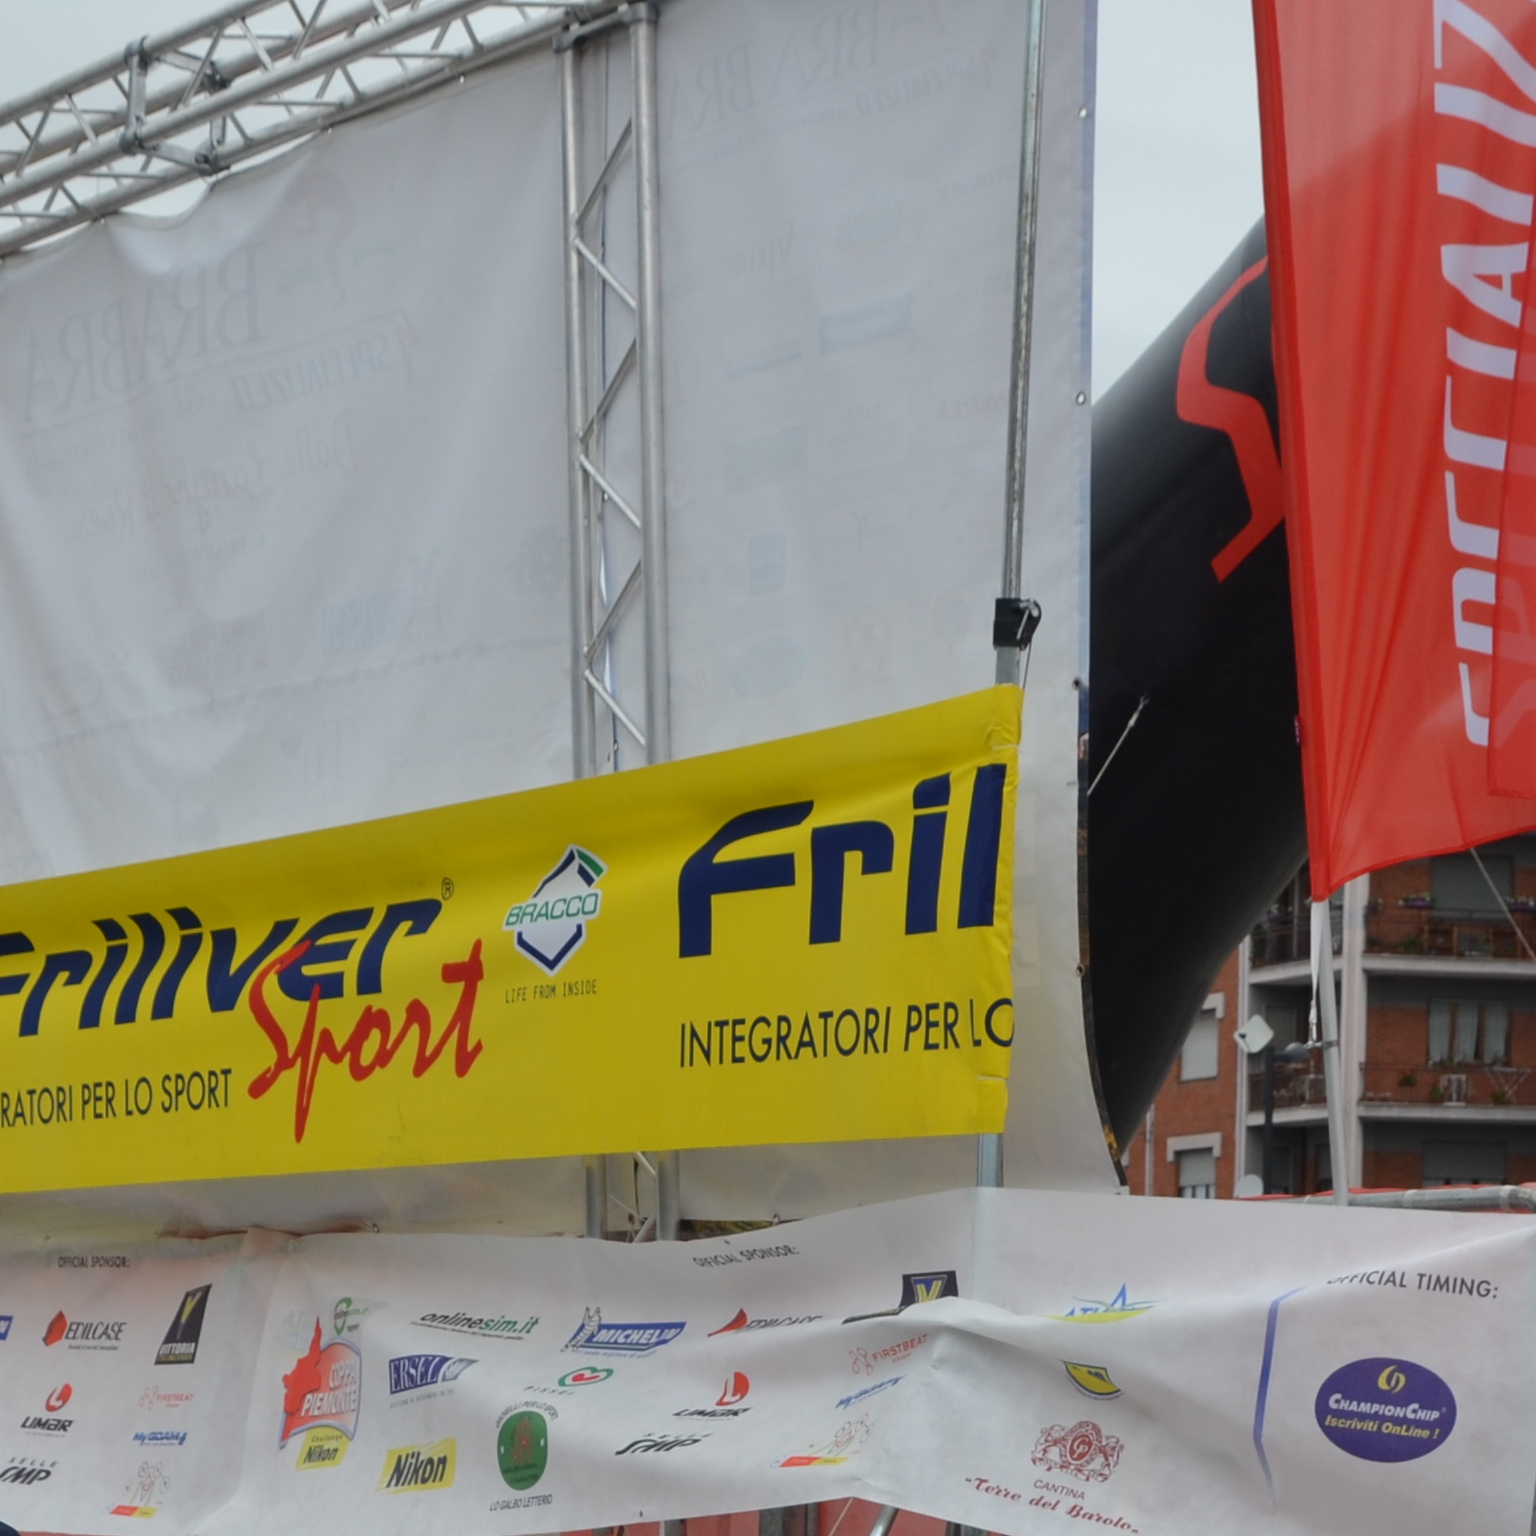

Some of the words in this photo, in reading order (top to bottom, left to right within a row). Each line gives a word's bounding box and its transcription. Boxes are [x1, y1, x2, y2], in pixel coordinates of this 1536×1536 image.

[677, 763, 1008, 959] Fril
[505, 892, 600, 927] BRACCO
[505, 986, 528, 1004] LIFE
[533, 984, 557, 1000] FROM
[562, 978, 598, 998] INSIDE
[247, 938, 484, 1144] Sport
[678, 1006, 892, 1069] INTEGRATORI
[902, 1000, 962, 1053] PER
[968, 996, 1015, 1048] LO
[80, 1081, 118, 1121] PER
[124, 1076, 154, 1118] LO
[160, 1068, 233, 1113] SPORT
[58, 1255, 89, 1269] OFFICIAL
[90, 1255, 131, 1269] SPONSOR:
[1416, 1272, 1500, 1300] TIMING:
[65, 1320, 127, 1341] EDILCASE
[421, 1312, 541, 1336] onlinesim.it
[871, 1333, 929, 1364] FIRSTBEAT
[389, 1355, 442, 1393] ERSEL
[300, 1390, 358, 1418] PIEMONTE
[1324, 1414, 1379, 1435] Iscriviti
[1381, 1420, 1430, 1440] OnLine
[7, 1456, 58, 1469] SELLE
[303, 1446, 339, 1465] Nikon
[385, 1453, 448, 1489] Nikon
[1028, 1495, 1060, 1512] del
[1032, 1478, 1087, 1501] CANTINA
